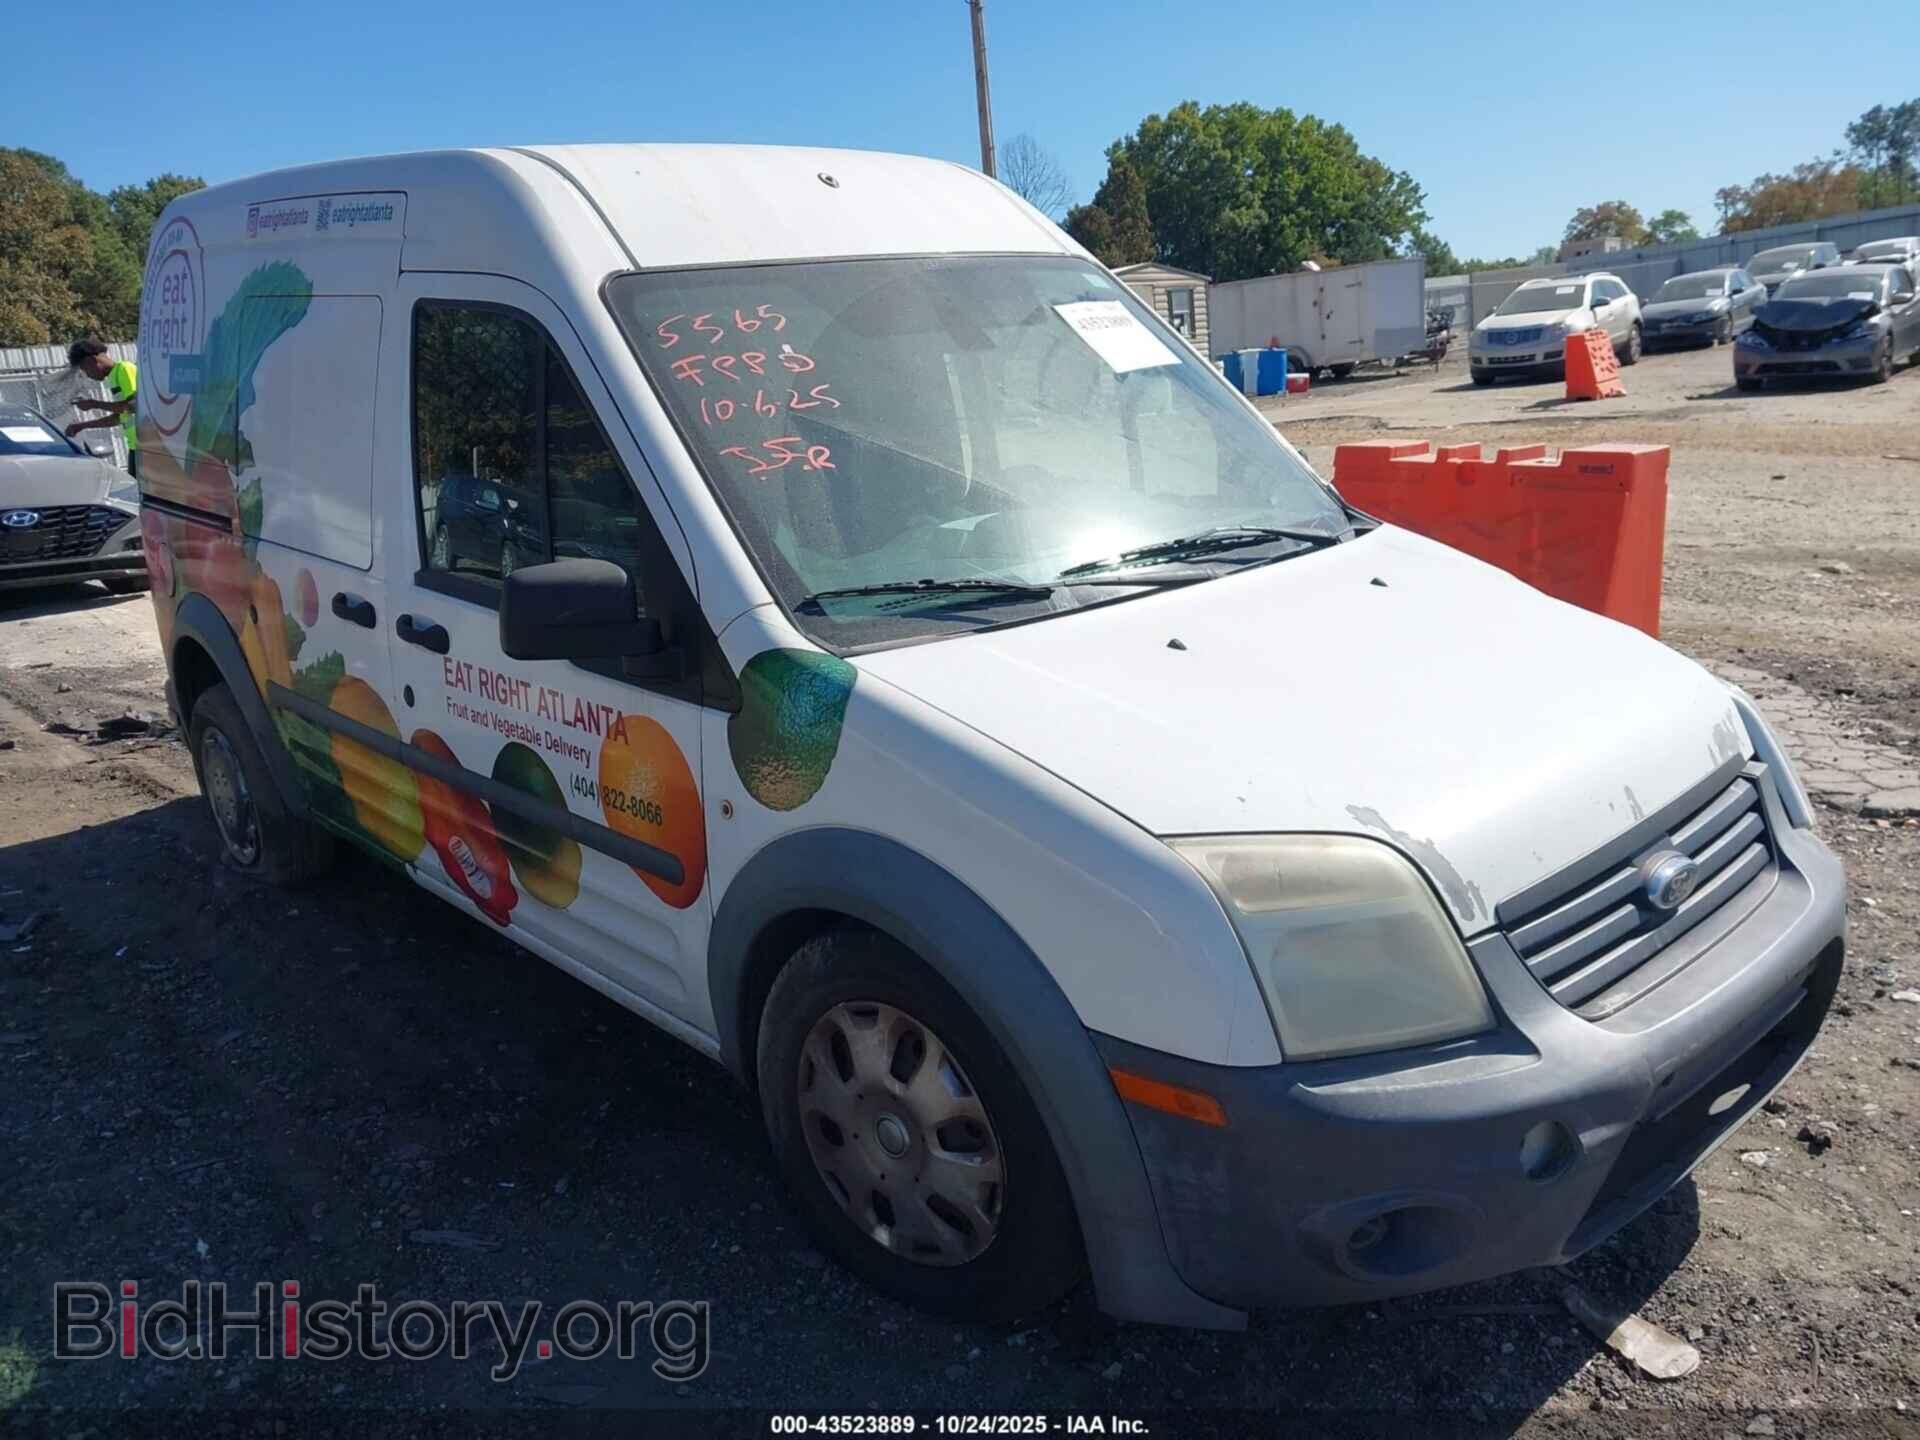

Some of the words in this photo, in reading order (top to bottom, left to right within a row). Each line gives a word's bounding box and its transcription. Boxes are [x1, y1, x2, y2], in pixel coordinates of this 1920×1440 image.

[161, 267, 188, 305] eat
[152, 307, 187, 359] right
[443, 656, 473, 693] EAT
[478, 668, 531, 712] RIGHT
[537, 687, 629, 745] ATLANTA
[446, 696, 470, 720] Fruit
[471, 707, 489, 728] and
[490, 711, 542, 747] Vegetable
[544, 731, 592, 768] Delivery
[570, 772, 600, 808] (404)
[603, 786, 663, 826] 822-8066
